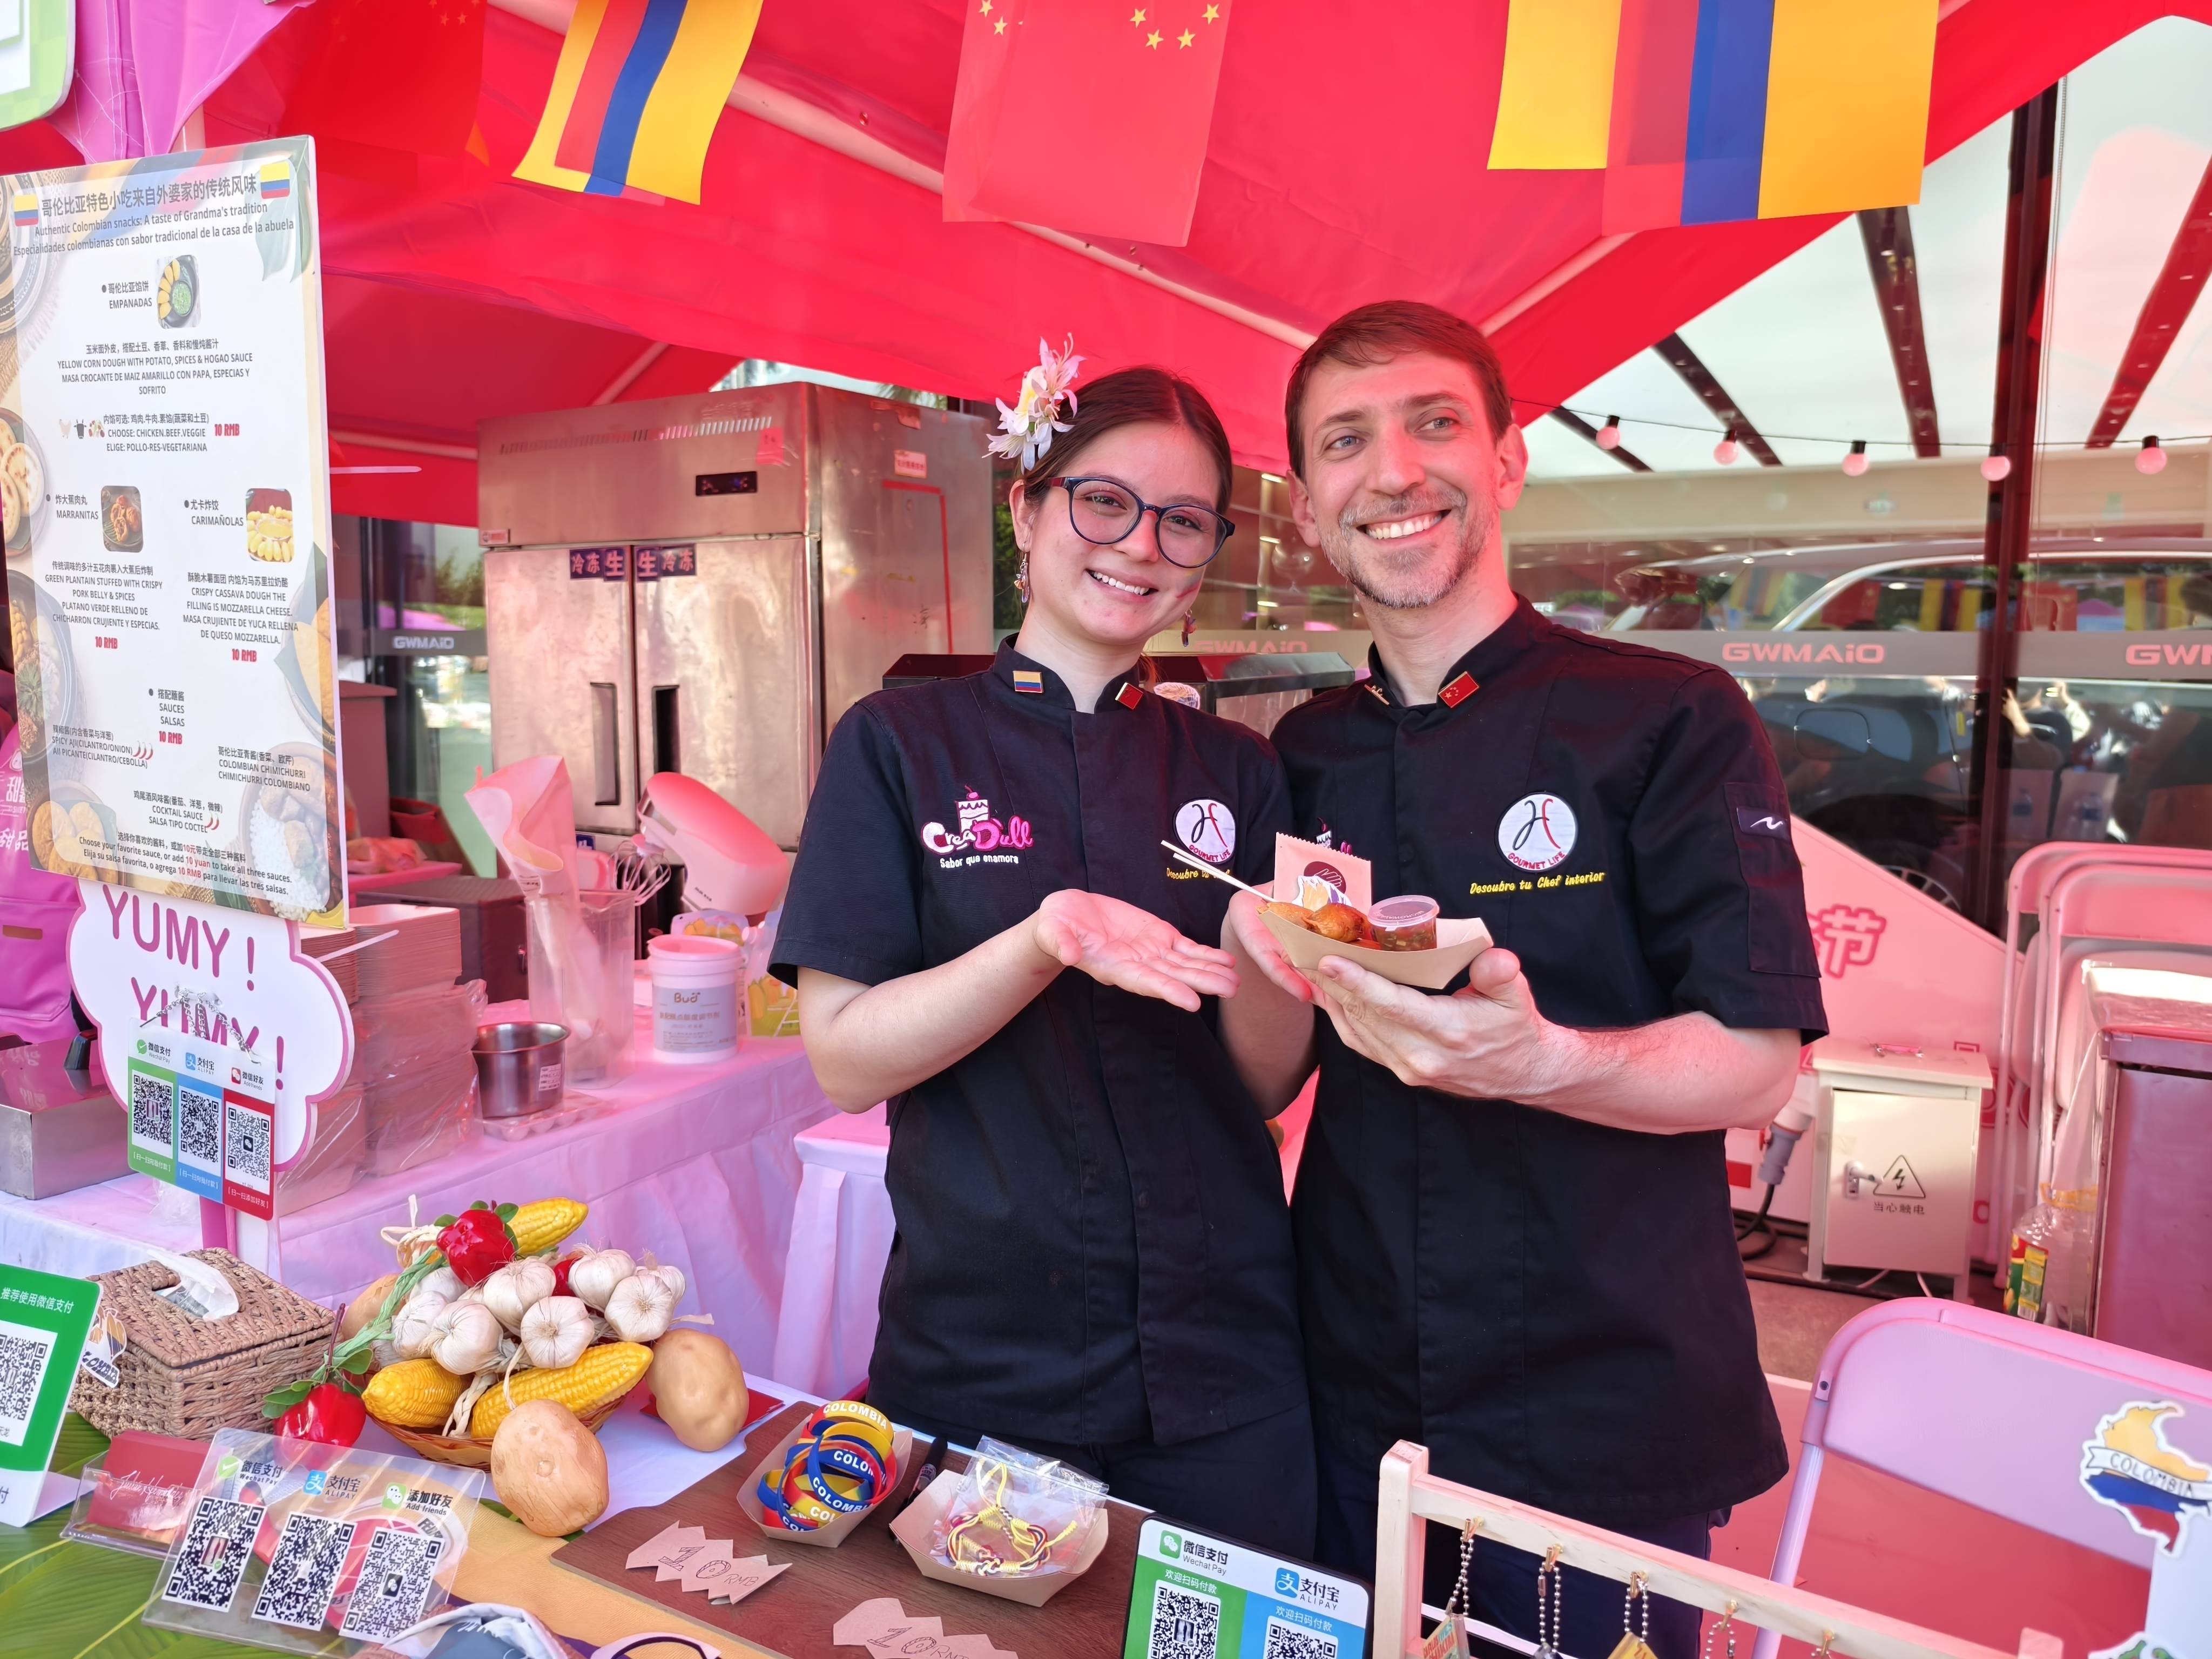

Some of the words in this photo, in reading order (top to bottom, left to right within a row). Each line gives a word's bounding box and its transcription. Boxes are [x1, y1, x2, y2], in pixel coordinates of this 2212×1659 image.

[42, 174, 256, 217] 哥伦比亚特色小吃来自外婆家的传统风味
[35, 224, 70, 237] Authentic
[72, 219, 112, 232] Colombian
[114, 217, 142, 227] snacks:
[152, 214, 172, 224] taste
[184, 207, 228, 220] Grandma's
[230, 202, 267, 217] tradition
[14, 242, 65, 258] Especialidades
[68, 238, 114, 251] colombianas
[116, 237, 129, 246] con
[132, 233, 152, 244] sabor
[156, 228, 198, 242] tradicional
[222, 225, 240, 236] casa
[265, 219, 294, 231] abuela
[108, 281, 149, 294] 哥伦比亚馅饼
[109, 298, 152, 309] EMPANADAS
[58, 360, 82, 368] YELLOW
[84, 359, 100, 368] CORN
[103, 359, 125, 367] DOUGH
[127, 358, 144, 366] WITH
[145, 357, 173, 366] POTATO,
[175, 355, 195, 364] SPICES
[204, 354, 229, 363] HOGAO
[231, 353, 253, 362] SAUCE
[63, 374, 79, 382] MASA
[81, 373, 113, 382] CROCANTE
[142, 371, 174, 380] AMARILLO
[177, 371, 190, 379] CON
[193, 370, 212, 379] PAPA,
[214, 369, 244, 378] ESPECIAS
[139, 386, 166, 394] SOFRITO
[215, 424, 222, 436] 10
[225, 423, 239, 436] RMB
[107, 443, 125, 451] ELIGE:
[127, 443, 207, 451] POLLO-RES-VEGETARIANA
[56, 495, 87, 505] 炸大蕉肉丸
[191, 500, 219, 510] 尤卡炸饺
[57, 510, 98, 520] MARRANITAS
[192, 515, 244, 526] CARIMAÑOLAS
[45, 575, 64, 583] GREEN
[66, 576, 95, 585] PLANTAIN
[97, 578, 122, 586] STUFFED
[124, 579, 139, 588] WITH
[141, 580, 162, 589] CRISPY
[91, 591, 107, 599] BELLY
[192, 588, 213, 596] CRISPY
[215, 589, 244, 598] CASSAVA
[246, 591, 271, 601] DOUGH
[273, 592, 286, 601] THE
[62, 602, 89, 611] PLATANO
[91, 604, 110, 612] VERDE
[112, 605, 138, 615] RELLENO
[187, 602, 211, 610] FILLING
[221, 604, 264, 614] MOZZARELLA
[266, 606, 292, 616] CHEESE.
[53, 614, 91, 624] CHICHARRON
[93, 617, 124, 627] CRUJIENTE
[131, 621, 160, 630] ESPECIAS.
[184, 615, 201, 623] MASA
[203, 617, 236, 626] CRUJIENTE
[248, 620, 266, 629] YUCA
[268, 622, 298, 631] RELLENA
[96, 636, 102, 648] 10
[104, 637, 118, 649] RMB
[211, 631, 233, 640] QUESO
[235, 633, 281, 644] MOZZARELLA.
[232, 649, 239, 660] 10
[241, 650, 257, 662] RMB
[160, 704, 184, 713] SAUCES
[161, 717, 185, 726] SALSAS
[52, 737, 67, 745] SPICY
[159, 731, 166, 742] 10
[168, 732, 182, 745] RMB
[219, 759, 259, 772] COLOMBIAN
[261, 765, 306, 778] CHIMICHURRI
[219, 771, 262, 784] CHIMICHURRI
[264, 778, 310, 792] COLOMBIANO
[153, 805, 181, 817] COCKTAIL
[184, 811, 203, 820] SAUCE
[149, 817, 167, 826] SALSA
[170, 820, 183, 829] TIPO
[185, 822, 207, 833] COCTEL
[79, 837, 100, 846] Choose
[102, 842, 115, 850] your
[117, 844, 141, 854] favorite
[143, 849, 162, 859] sauce,
[195, 859, 210, 867] yuan
[267, 873, 292, 883] sauces.
[1189, 845, 1218, 861] GOURMET
[1219, 849, 1231, 860] LIFE
[1508, 853, 1545, 869] GOURMET
[1548, 851, 1566, 865] LIFE
[940, 858, 963, 868] Sabor
[966, 855, 980, 866] que
[983, 855, 1019, 864] enamora
[123, 856, 148, 869] favorita,
[156, 865, 176, 874] agrega
[266, 885, 288, 895] salsas.
[1166, 868, 1198, 879] Descubre
[1470, 881, 1515, 894] Descubre
[1519, 880, 1532, 891] tu
[1537, 875, 1562, 888] Chef
[1565, 872, 1606, 885] interior
[149, 1042, 171, 1057] 微信支付
[197, 1057, 214, 1071] 支付宝
[242, 1071, 264, 1084] 微信好友
[1874, 1202, 1925, 1214] 当心触电
[1, 1287, 74, 1314] 推荐使用微信支付
[823, 1403, 886, 1429] COLOMBIA
[241, 1460, 284, 1478] 微信支付
[2110, 1453, 2194, 1498] COLOMBIA
[240, 1473, 264, 1482] Wechat
[327, 1475, 361, 1493] 支付宝
[325, 1489, 356, 1499] ALIPAY
[407, 1489, 454, 1508] 添加好友
[406, 1503, 422, 1512] Add
[423, 1506, 447, 1516] friends
[1183, 1540, 1228, 1565] 微信支付
[658, 1546, 731, 1579] 10
[724, 1574, 759, 1586] RMB
[1183, 1554, 1211, 1569] Wechat
[1212, 1564, 1226, 1576] Pay
[1165, 1569, 1217, 1595] 欢迎扫码付款
[1300, 1577, 1340, 1603] 支付宝
[1300, 1593, 1338, 1611] ALIPAY
[1276, 1606, 1332, 1633] 欢迎扫码付款
